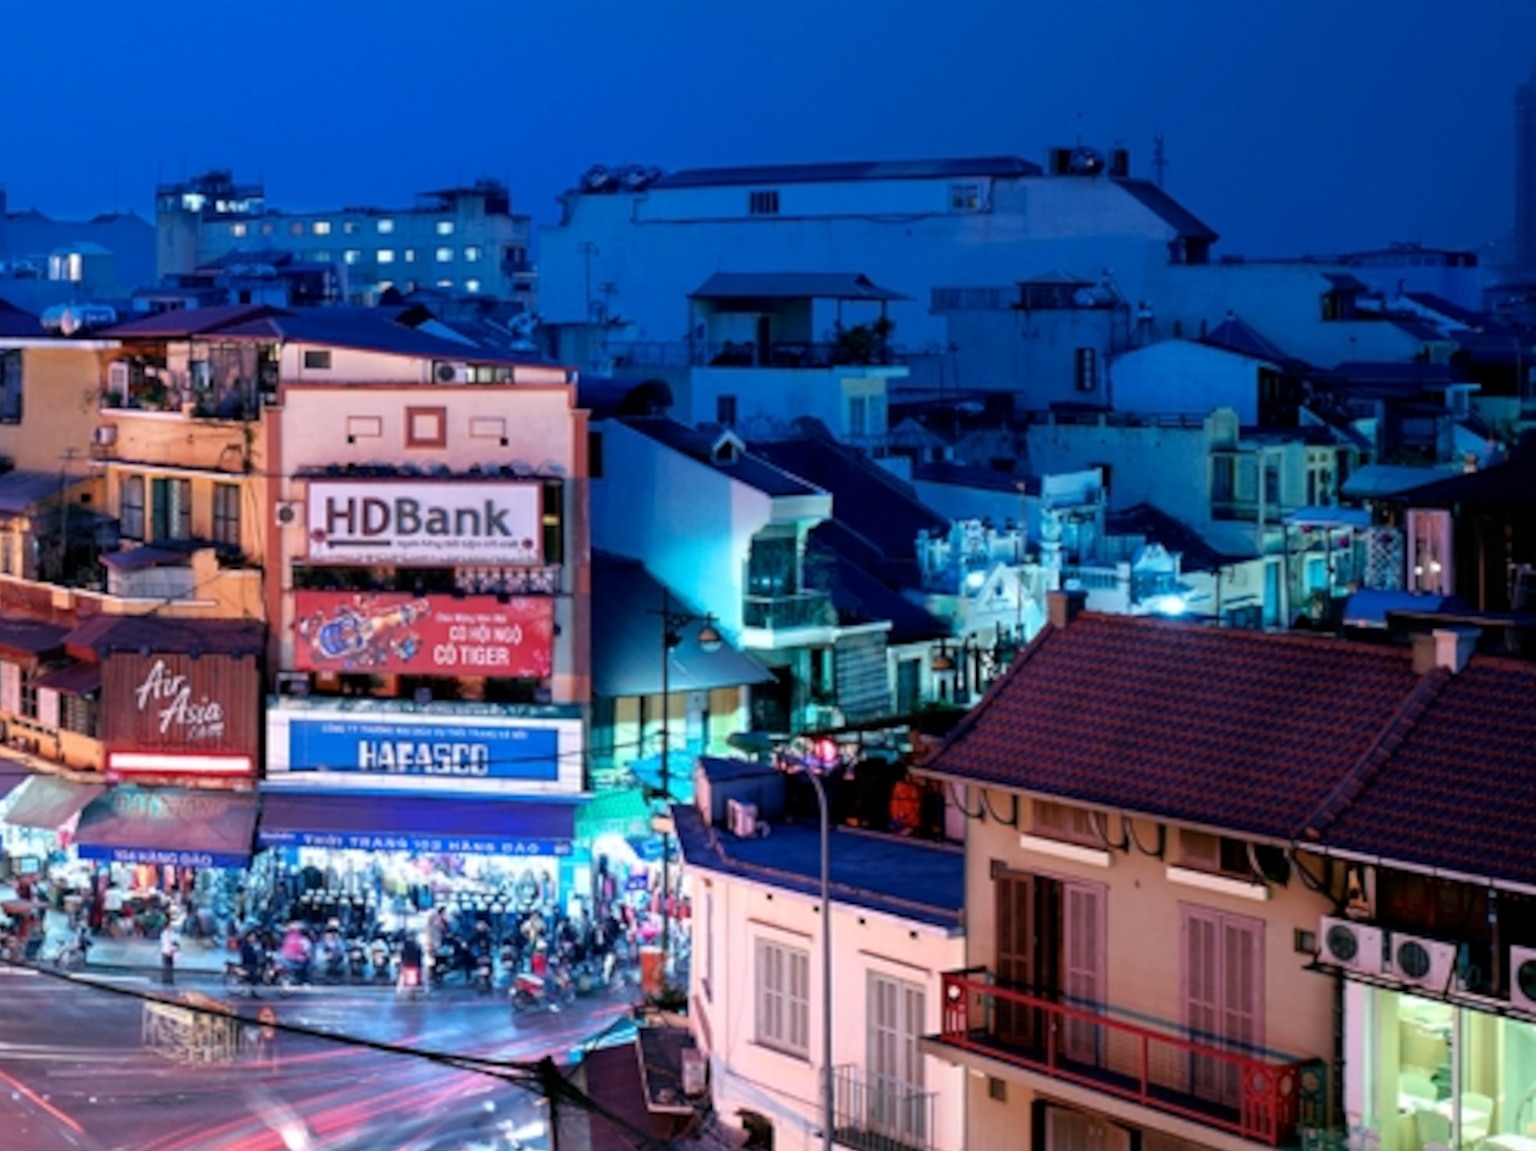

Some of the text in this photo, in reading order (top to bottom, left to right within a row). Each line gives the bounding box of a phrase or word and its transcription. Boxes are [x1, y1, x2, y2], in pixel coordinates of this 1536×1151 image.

[326, 497, 512, 537] HDBank
[460, 644, 511, 666] TIGER
[134, 658, 186, 710] Air
[158, 685, 222, 734] Asia
[358, 738, 490, 777] HAFASCO
